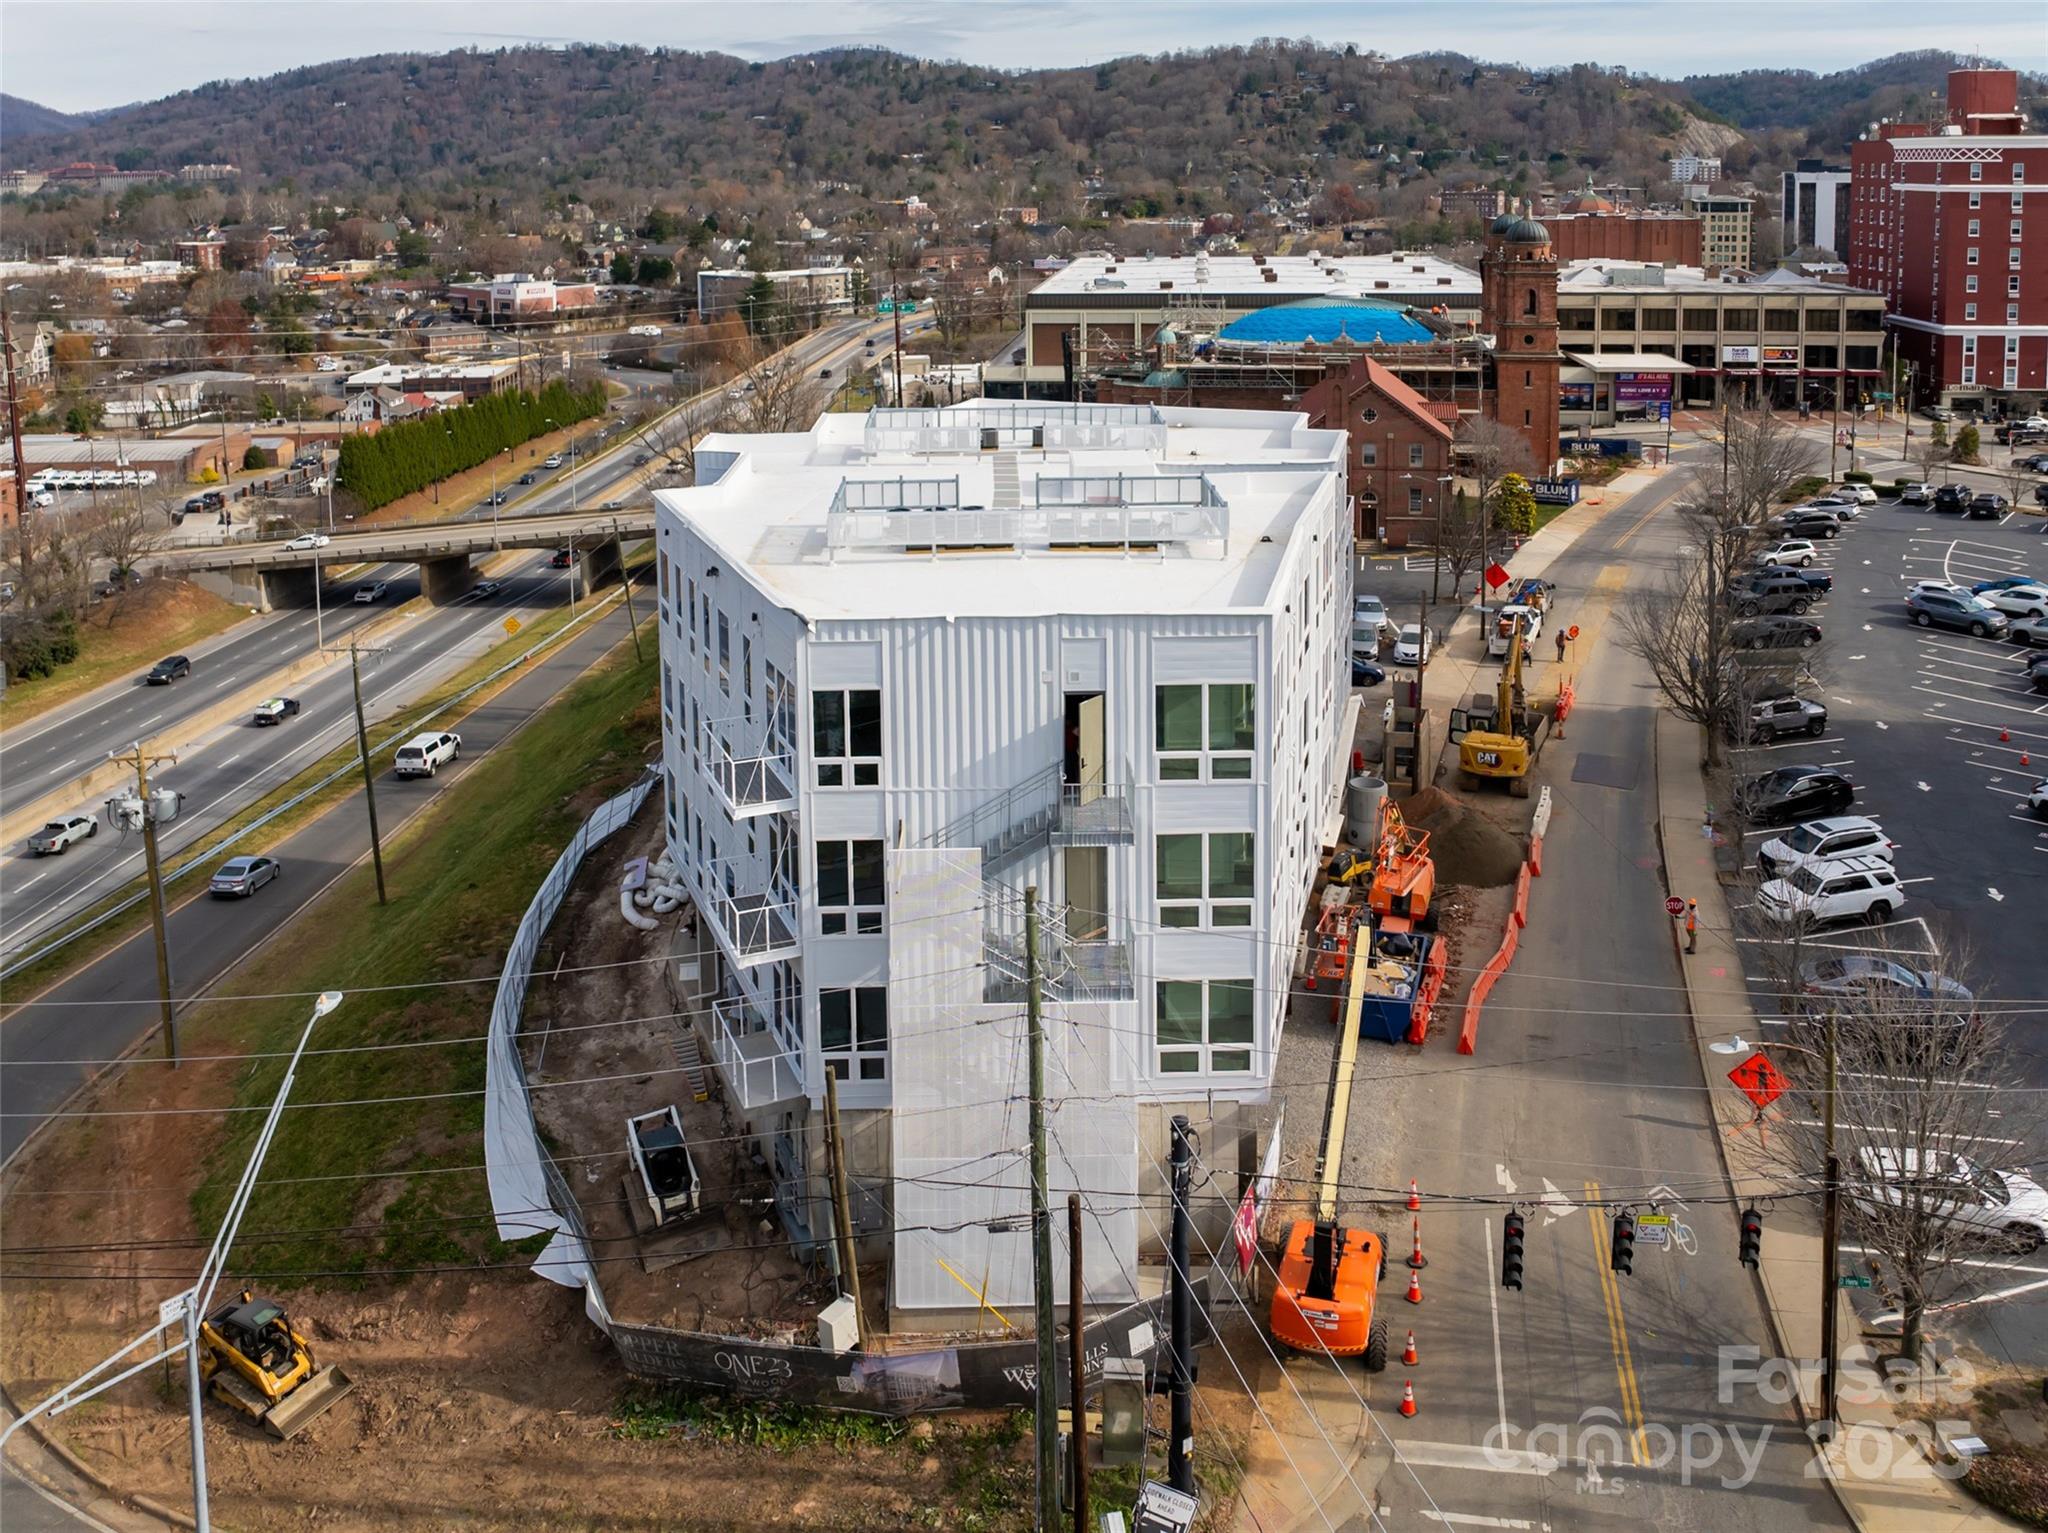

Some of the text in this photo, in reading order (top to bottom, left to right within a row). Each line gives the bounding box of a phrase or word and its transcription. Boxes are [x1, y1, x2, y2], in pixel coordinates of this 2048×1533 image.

[1571, 443, 1600, 452] BLUM
[1535, 484, 1569, 496] BLUM
[1477, 752, 1497, 765] CAT
[1666, 901, 1684, 910] STOP
[1146, 1486, 1193, 1512] SIDEWALK CLOSED
[1157, 1503, 1176, 1515] AHEAD
